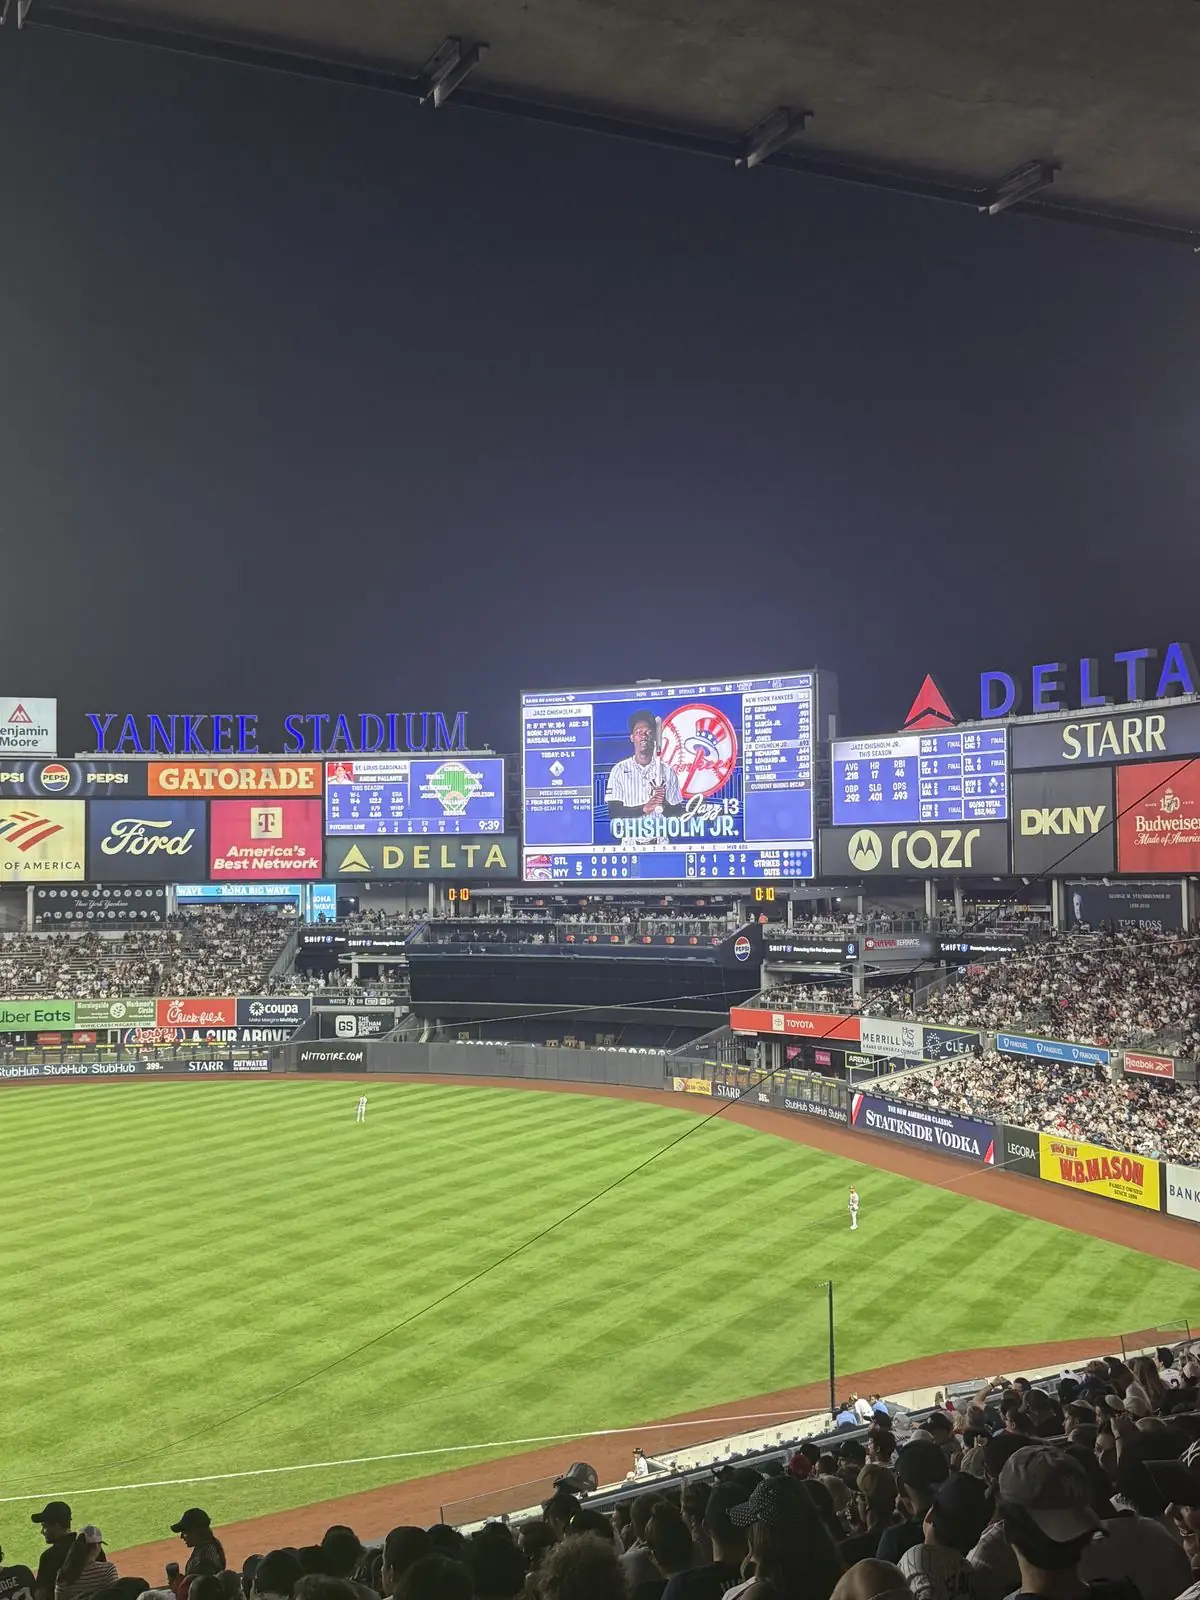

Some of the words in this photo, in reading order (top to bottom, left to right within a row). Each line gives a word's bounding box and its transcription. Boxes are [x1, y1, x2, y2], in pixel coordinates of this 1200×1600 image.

[980, 642, 1196, 718] DELTA
[0, 725, 49, 738] enjamin
[85, 713, 259, 754] YANKEE
[283, 711, 469, 753] STADIUM
[1062, 714, 1167, 760] STARR
[0, 736, 39, 747] Moore
[844, 763, 859, 771] AVG
[870, 761, 880, 770] HR
[893, 760, 906, 768] RBI
[0, 772, 25, 783] PSI
[43, 774, 69, 782] PEPSI
[86, 773, 129, 784] PEPSI
[159, 767, 315, 790] GATORADE
[894, 769, 905, 777] 46
[844, 784, 859, 793] OBP
[868, 783, 882, 792] SLG
[892, 782, 907, 790] OPS
[680, 794, 722, 823] Jazz
[723, 798, 739, 815] 13
[478, 820, 500, 830] 9:39
[610, 816, 705, 839] CHISHOLM
[709, 815, 739, 837] JR.
[1020, 805, 1106, 836] DKNY
[100, 818, 196, 856] Ford
[1133, 833, 1160, 846] Made
[226, 845, 306, 858] America's
[891, 828, 980, 869] razr
[383, 844, 507, 869] DELTA
[553, 856, 568, 865] STL
[753, 859, 780, 867] STRIKES
[4, 862, 20, 870] OF
[24, 861, 81, 870] AMERICA
[213, 858, 251, 870] Best
[252, 857, 319, 870] Network
[575, 861, 583, 871] 5
[553, 869, 569, 877] NYY
[177, 887, 203, 895] WAVE
[448, 888, 469, 901] 0:10
[755, 887, 775, 901] 0:10
[896, 938, 920, 947] TERRACE
[0, 1010, 31, 1023] Uber
[34, 1010, 71, 1022] Eats
[167, 1005, 226, 1025] Chick-fil-A
[265, 1004, 299, 1016] coupa
[338, 1021, 354, 1031] GS
[786, 1019, 815, 1030] TOYOTA
[862, 1032, 901, 1046] MERRILL
[301, 1050, 364, 1062] NITTOTIRE.COM
[848, 1055, 871, 1064] ARENA
[0, 1066, 39, 1077] tubHub
[43, 1064, 88, 1075] StubHub
[92, 1062, 136, 1074] StubHub
[146, 1062, 159, 1070] 399
[188, 1061, 224, 1071] STARR
[1125, 1056, 1155, 1071] Reebok
[717, 1085, 741, 1099] STARR
[785, 1099, 808, 1111] StubHub
[809, 1103, 827, 1117] StubHub
[828, 1108, 847, 1122] StubHub
[887, 1105, 898, 1114] THE
[907, 1110, 932, 1123] AMERICAN
[931, 1115, 954, 1128] CLASSIC.
[865, 1109, 933, 1143] STATESIDE
[934, 1126, 981, 1156] VODKA
[1007, 1142, 1036, 1160] LEGORA
[1050, 1143, 1065, 1154] WHO
[1065, 1147, 1078, 1158] BUT
[1169, 1184, 1200, 1203] BANK
